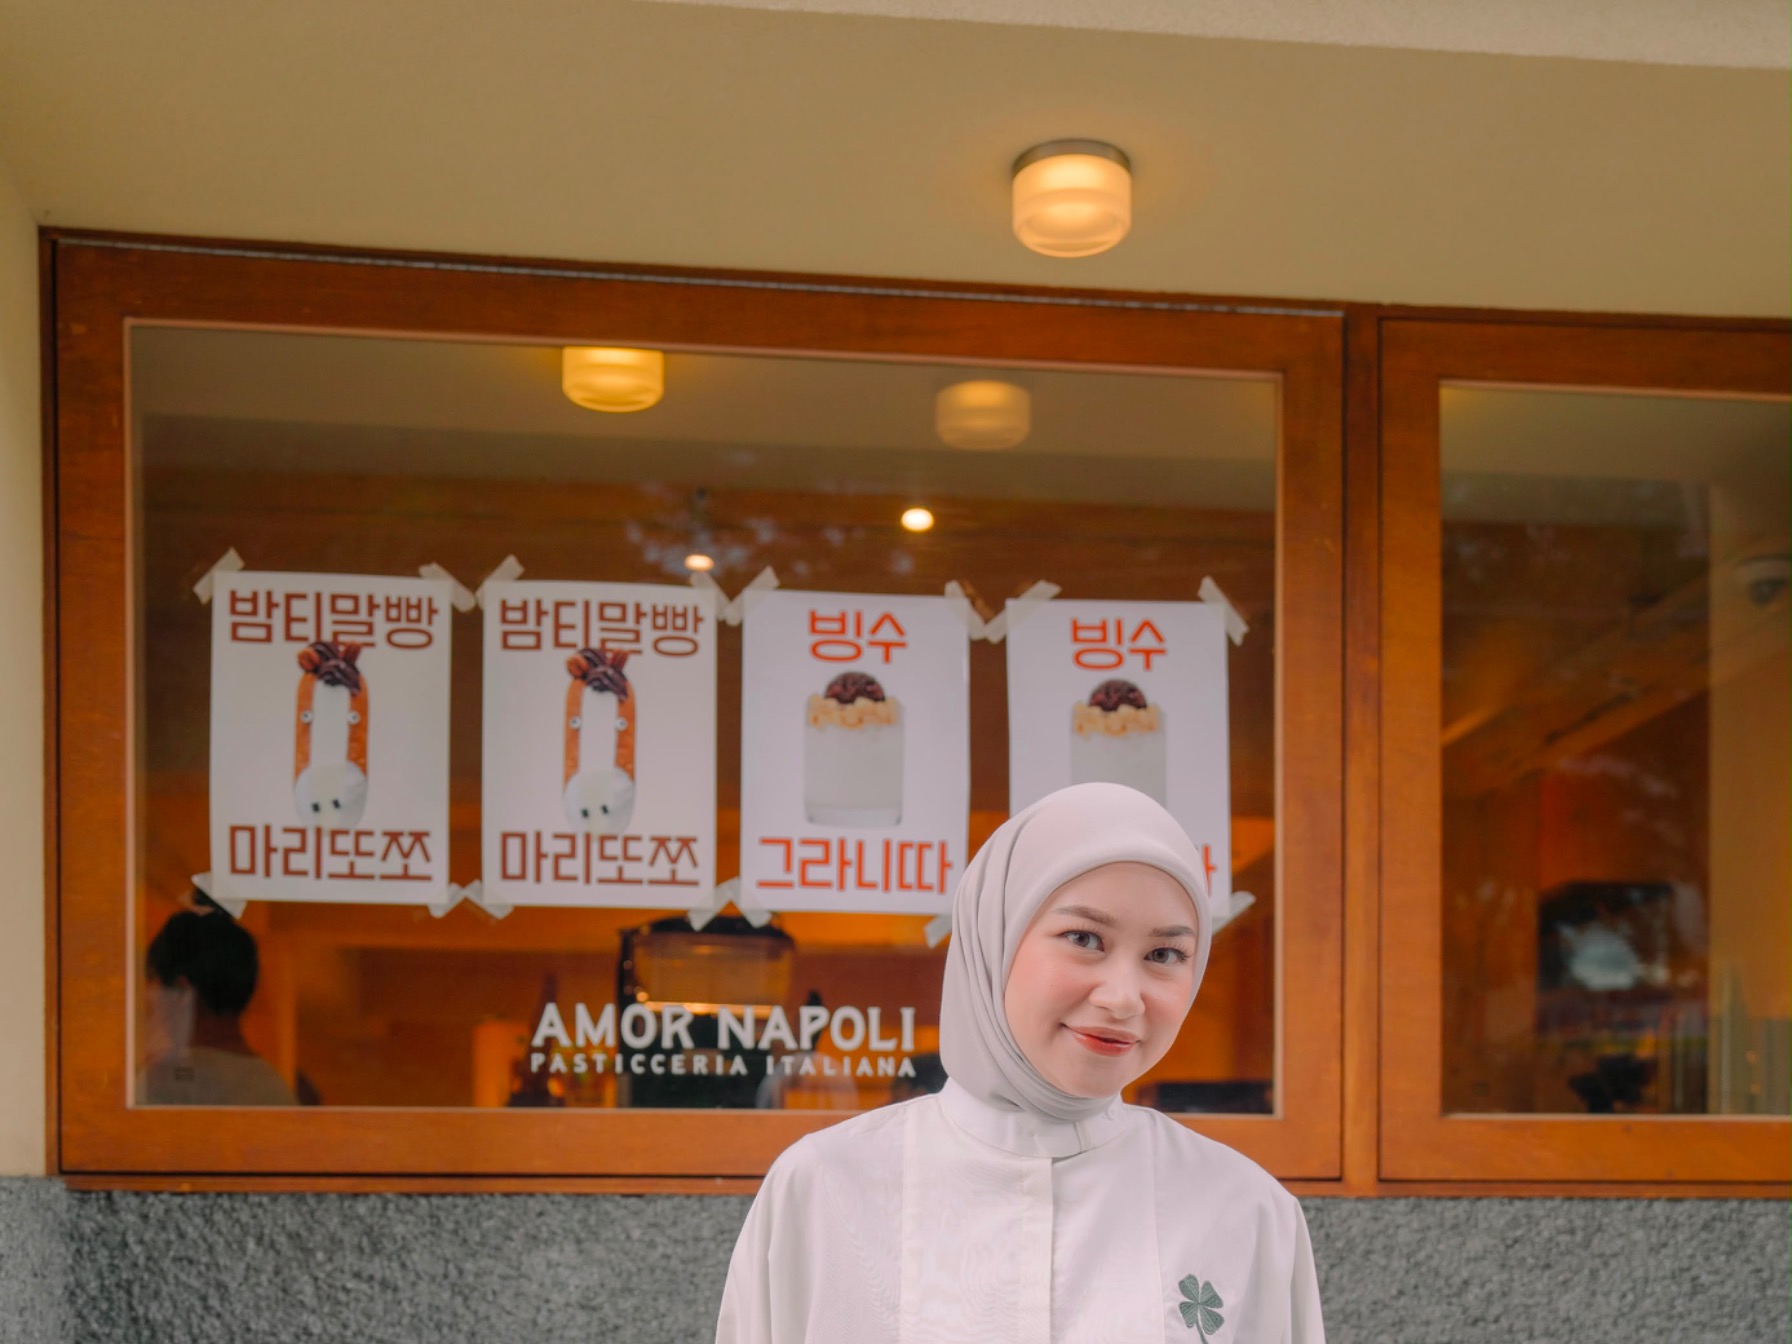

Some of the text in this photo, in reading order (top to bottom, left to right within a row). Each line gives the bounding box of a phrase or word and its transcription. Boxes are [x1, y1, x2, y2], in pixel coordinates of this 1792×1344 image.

[229, 589, 438, 651] 밤티말빵
[499, 597, 704, 658] 밤티말빵
[807, 609, 908, 665] 빙수
[1070, 617, 1168, 672] 빙수
[228, 823, 434, 882] 마리또쪼
[499, 830, 700, 887] 마리또쪼
[756, 836, 953, 895] 그라니따
[531, 1002, 916, 1052] AMOR NAPOLI
[530, 1051, 917, 1078] PASTICCERIA ITALIANA
